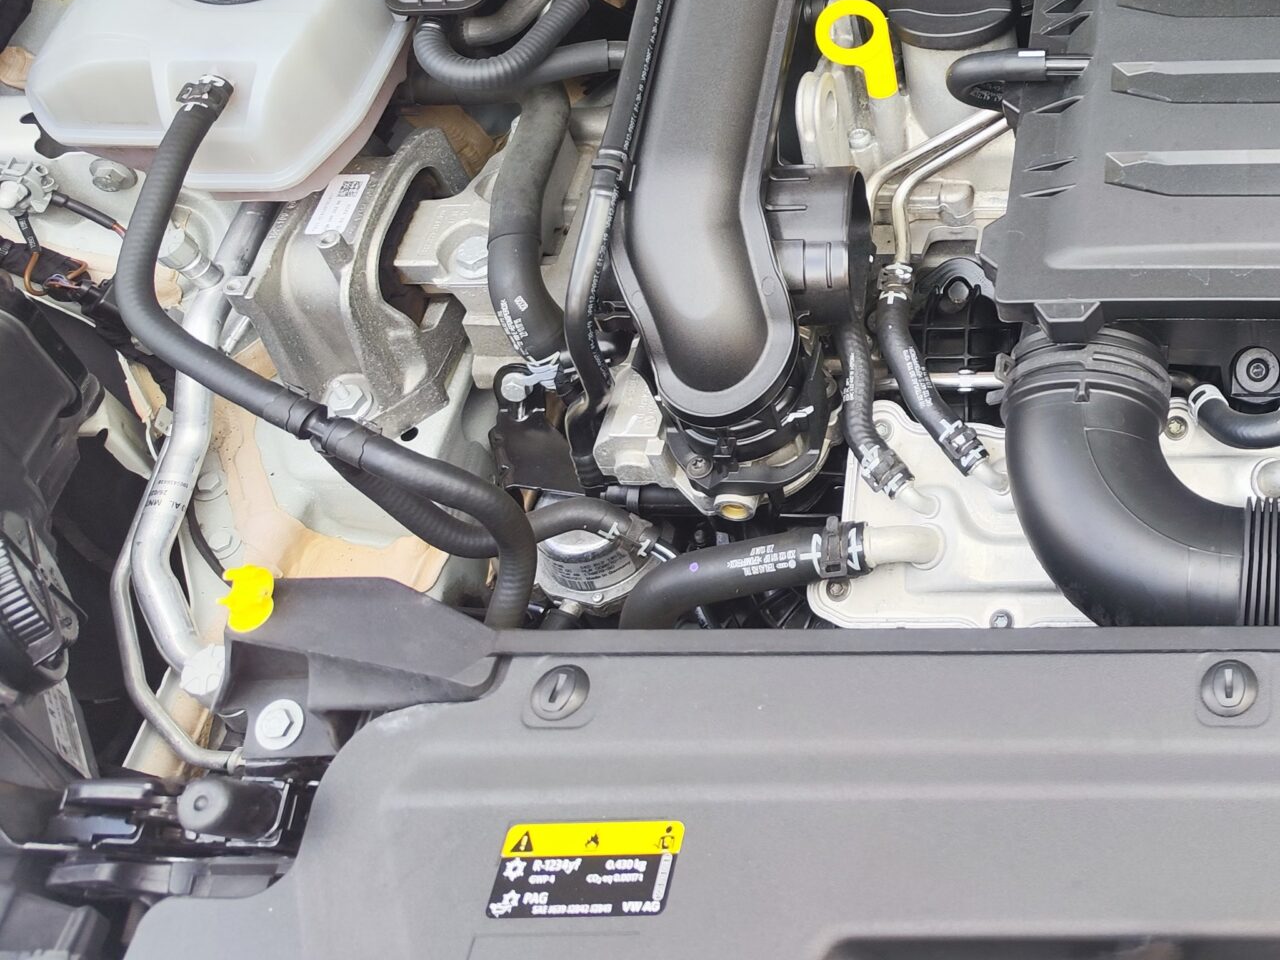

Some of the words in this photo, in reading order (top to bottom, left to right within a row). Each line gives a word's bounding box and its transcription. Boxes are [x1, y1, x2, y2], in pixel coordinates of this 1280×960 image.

[522, 892, 549, 904] PAG
[621, 901, 643, 913] VW
[641, 901, 661, 913] AG
